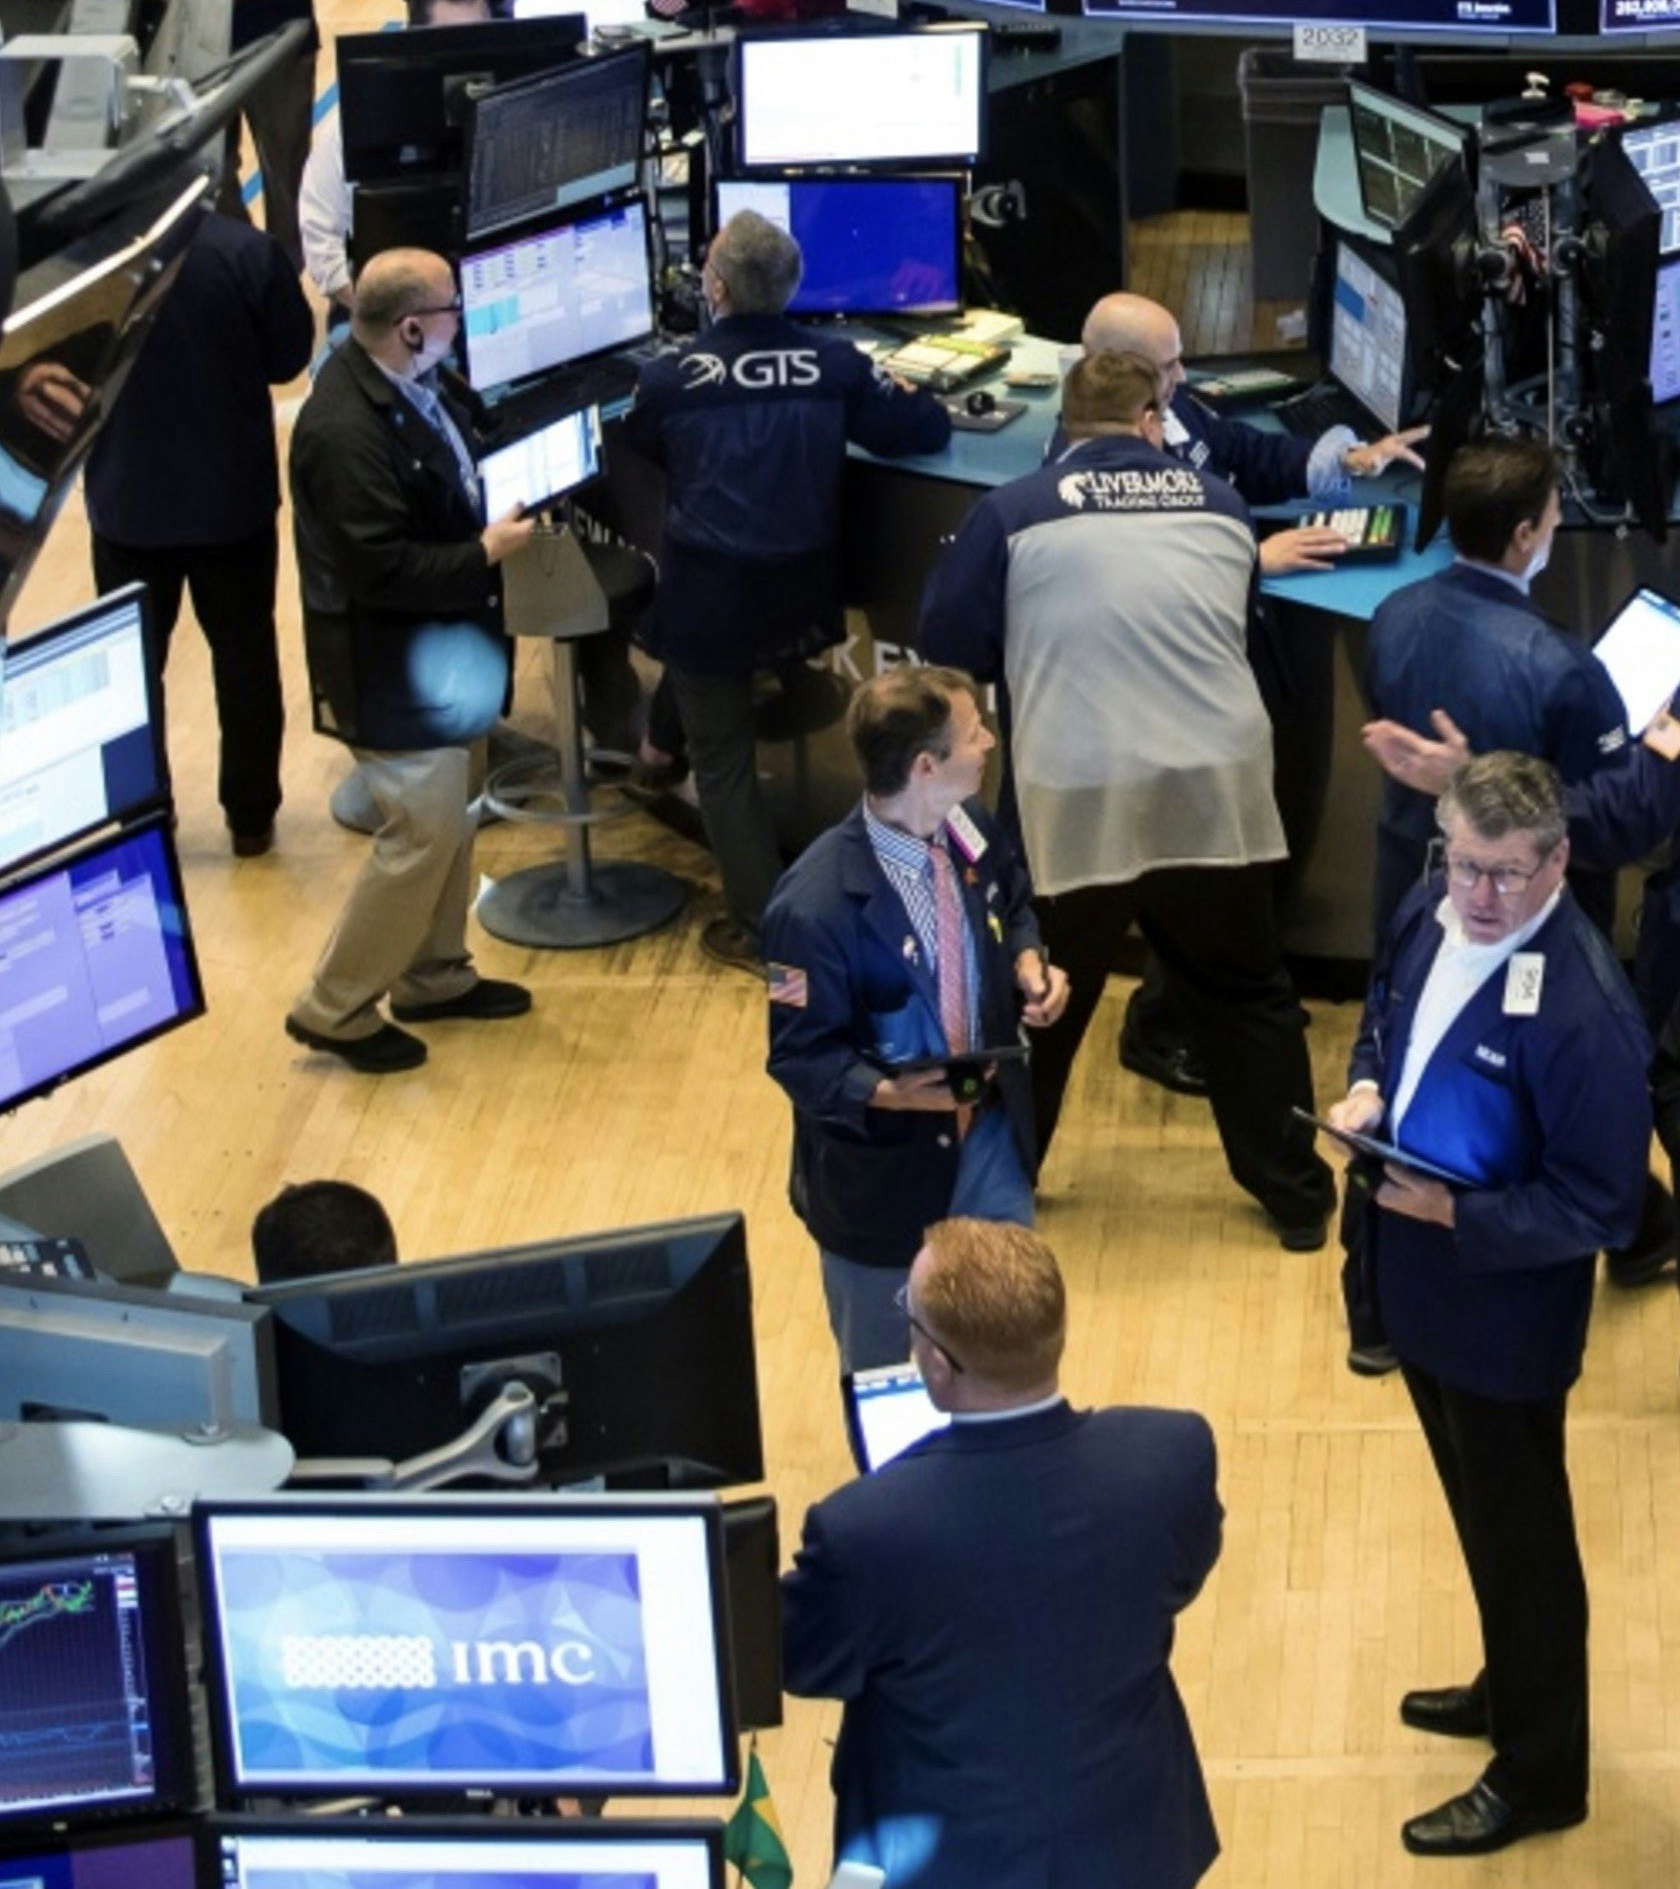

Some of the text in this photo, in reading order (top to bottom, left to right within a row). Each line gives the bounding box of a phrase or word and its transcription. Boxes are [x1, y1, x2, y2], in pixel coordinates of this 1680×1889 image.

[731, 348, 822, 391] GTS
[1089, 470, 1205, 497] LIVERMORE
[451, 1634, 598, 1687] imc
